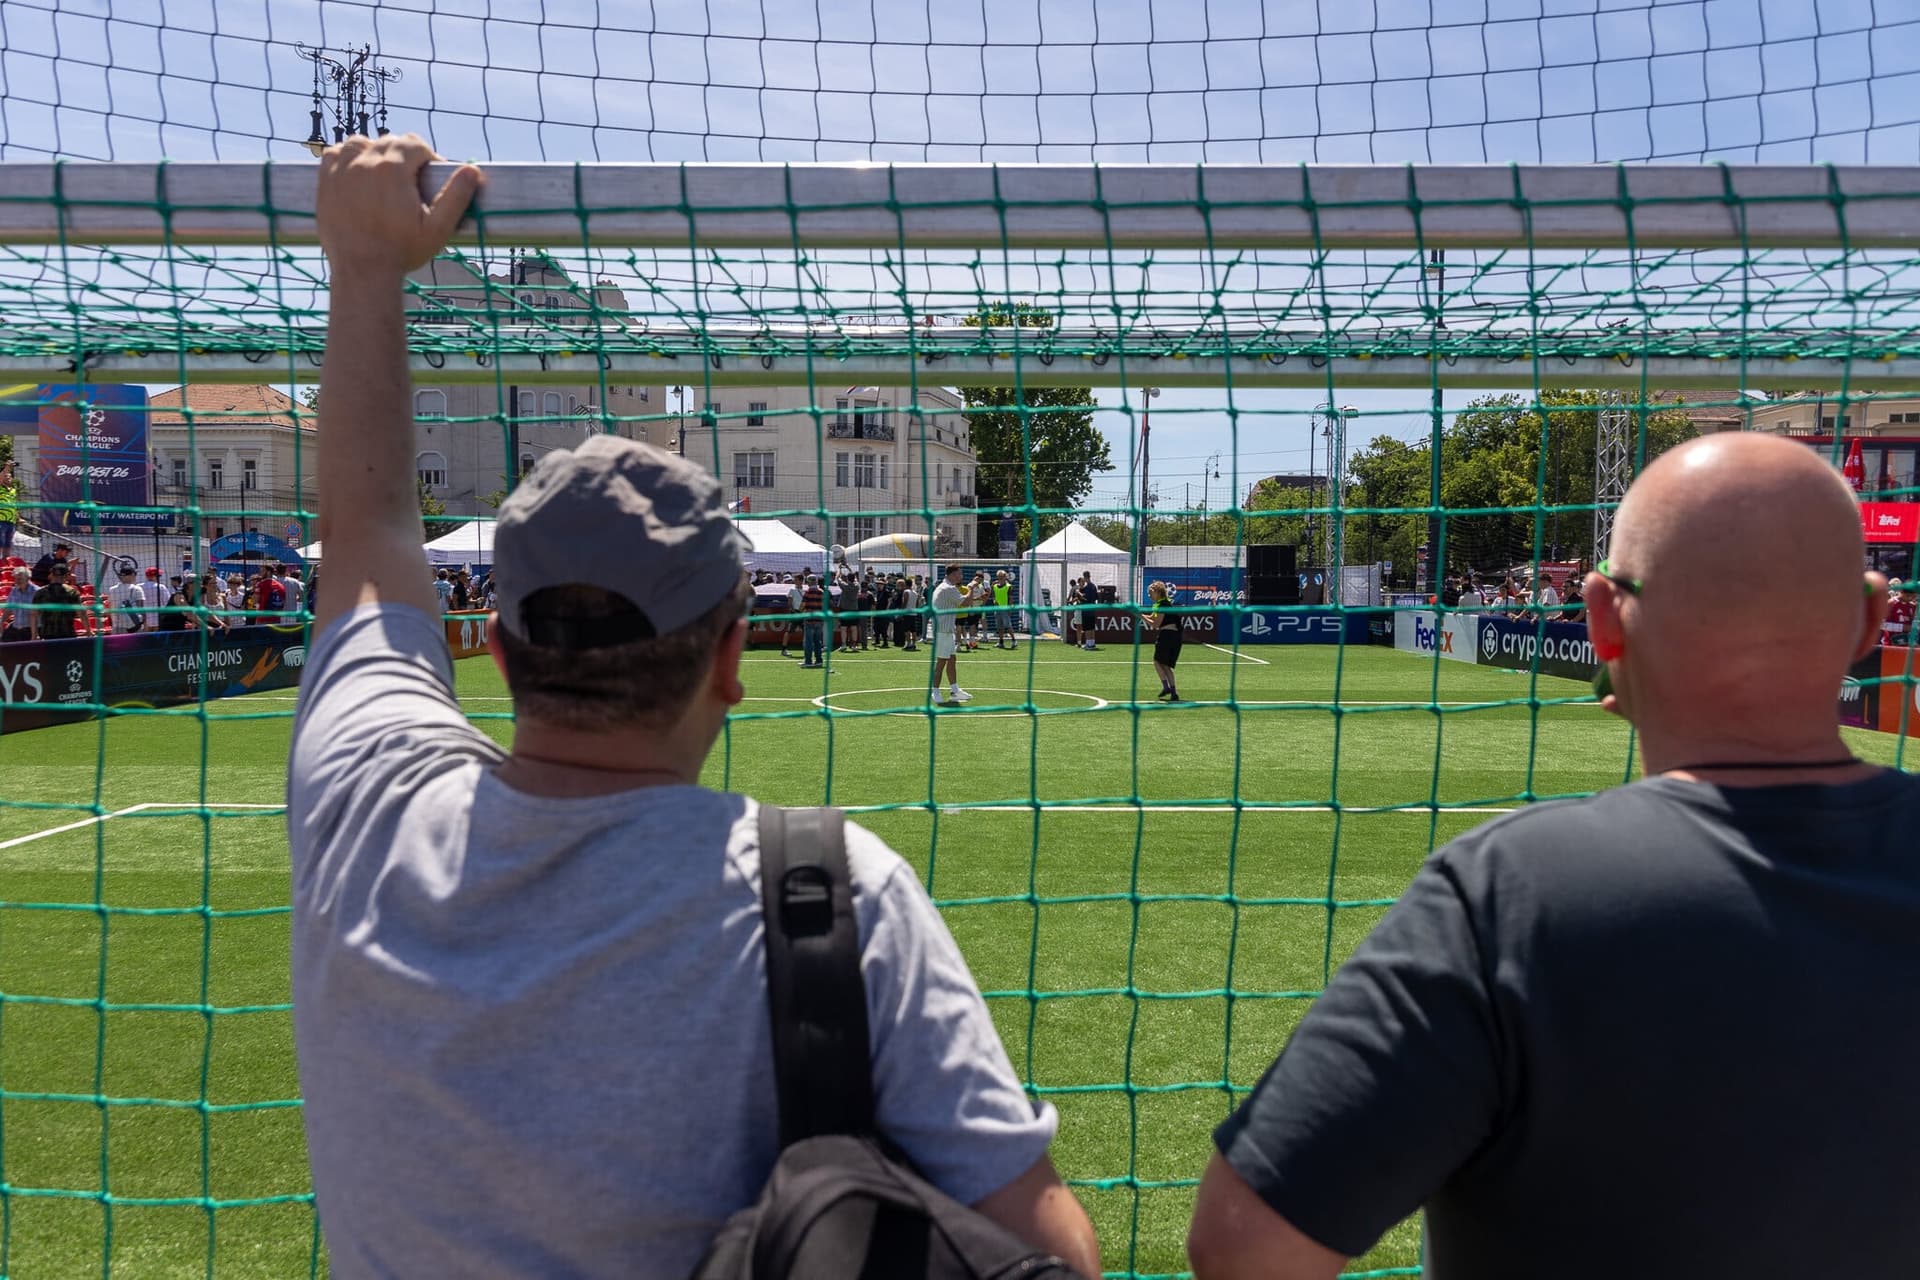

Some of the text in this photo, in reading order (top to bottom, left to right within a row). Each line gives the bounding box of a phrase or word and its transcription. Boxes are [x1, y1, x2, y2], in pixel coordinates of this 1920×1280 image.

[112, 467, 129, 478] 26
[76, 477, 110, 485] NAL
[75, 510, 109, 519] VÍZNT
[117, 512, 169, 520] WATERPONT
[1070, 616, 1215, 631] TAR AAYS
[1278, 616, 1343, 631] PS5
[1415, 616, 1454, 653] FedEx
[0, 661, 43, 705] YS
[187, 671, 229, 685] FESIVAL
